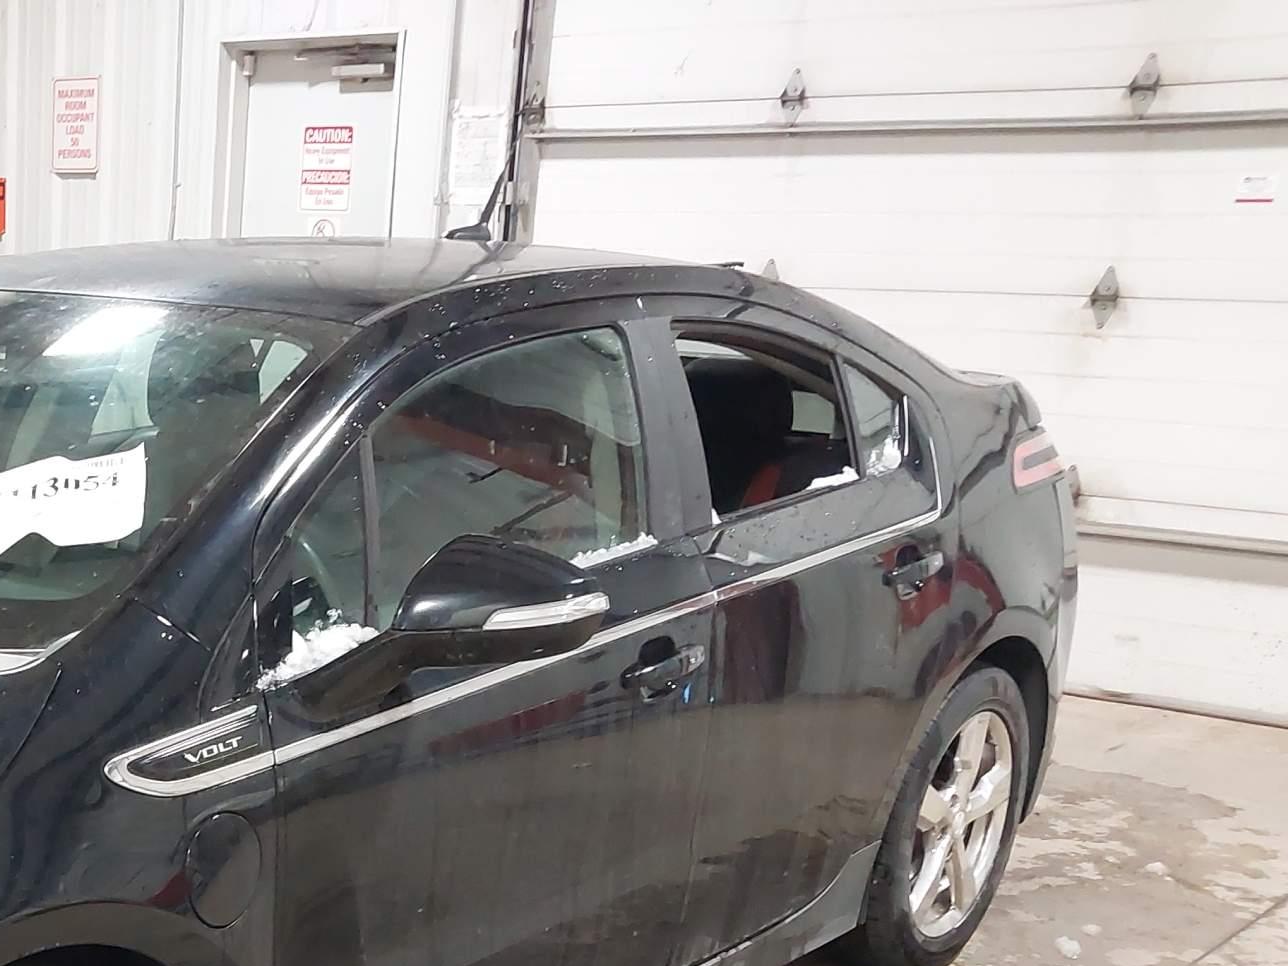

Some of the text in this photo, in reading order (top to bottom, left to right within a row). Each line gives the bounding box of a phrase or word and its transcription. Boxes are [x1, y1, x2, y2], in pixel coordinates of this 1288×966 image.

[57, 88, 95, 98] MAXIMUM
[64, 100, 87, 111] ROOM
[56, 112, 94, 123] OCCUPANT
[65, 125, 85, 135] LOAD
[57, 148, 91, 159] PERSONS
[183, 736, 243, 764] VOLT
